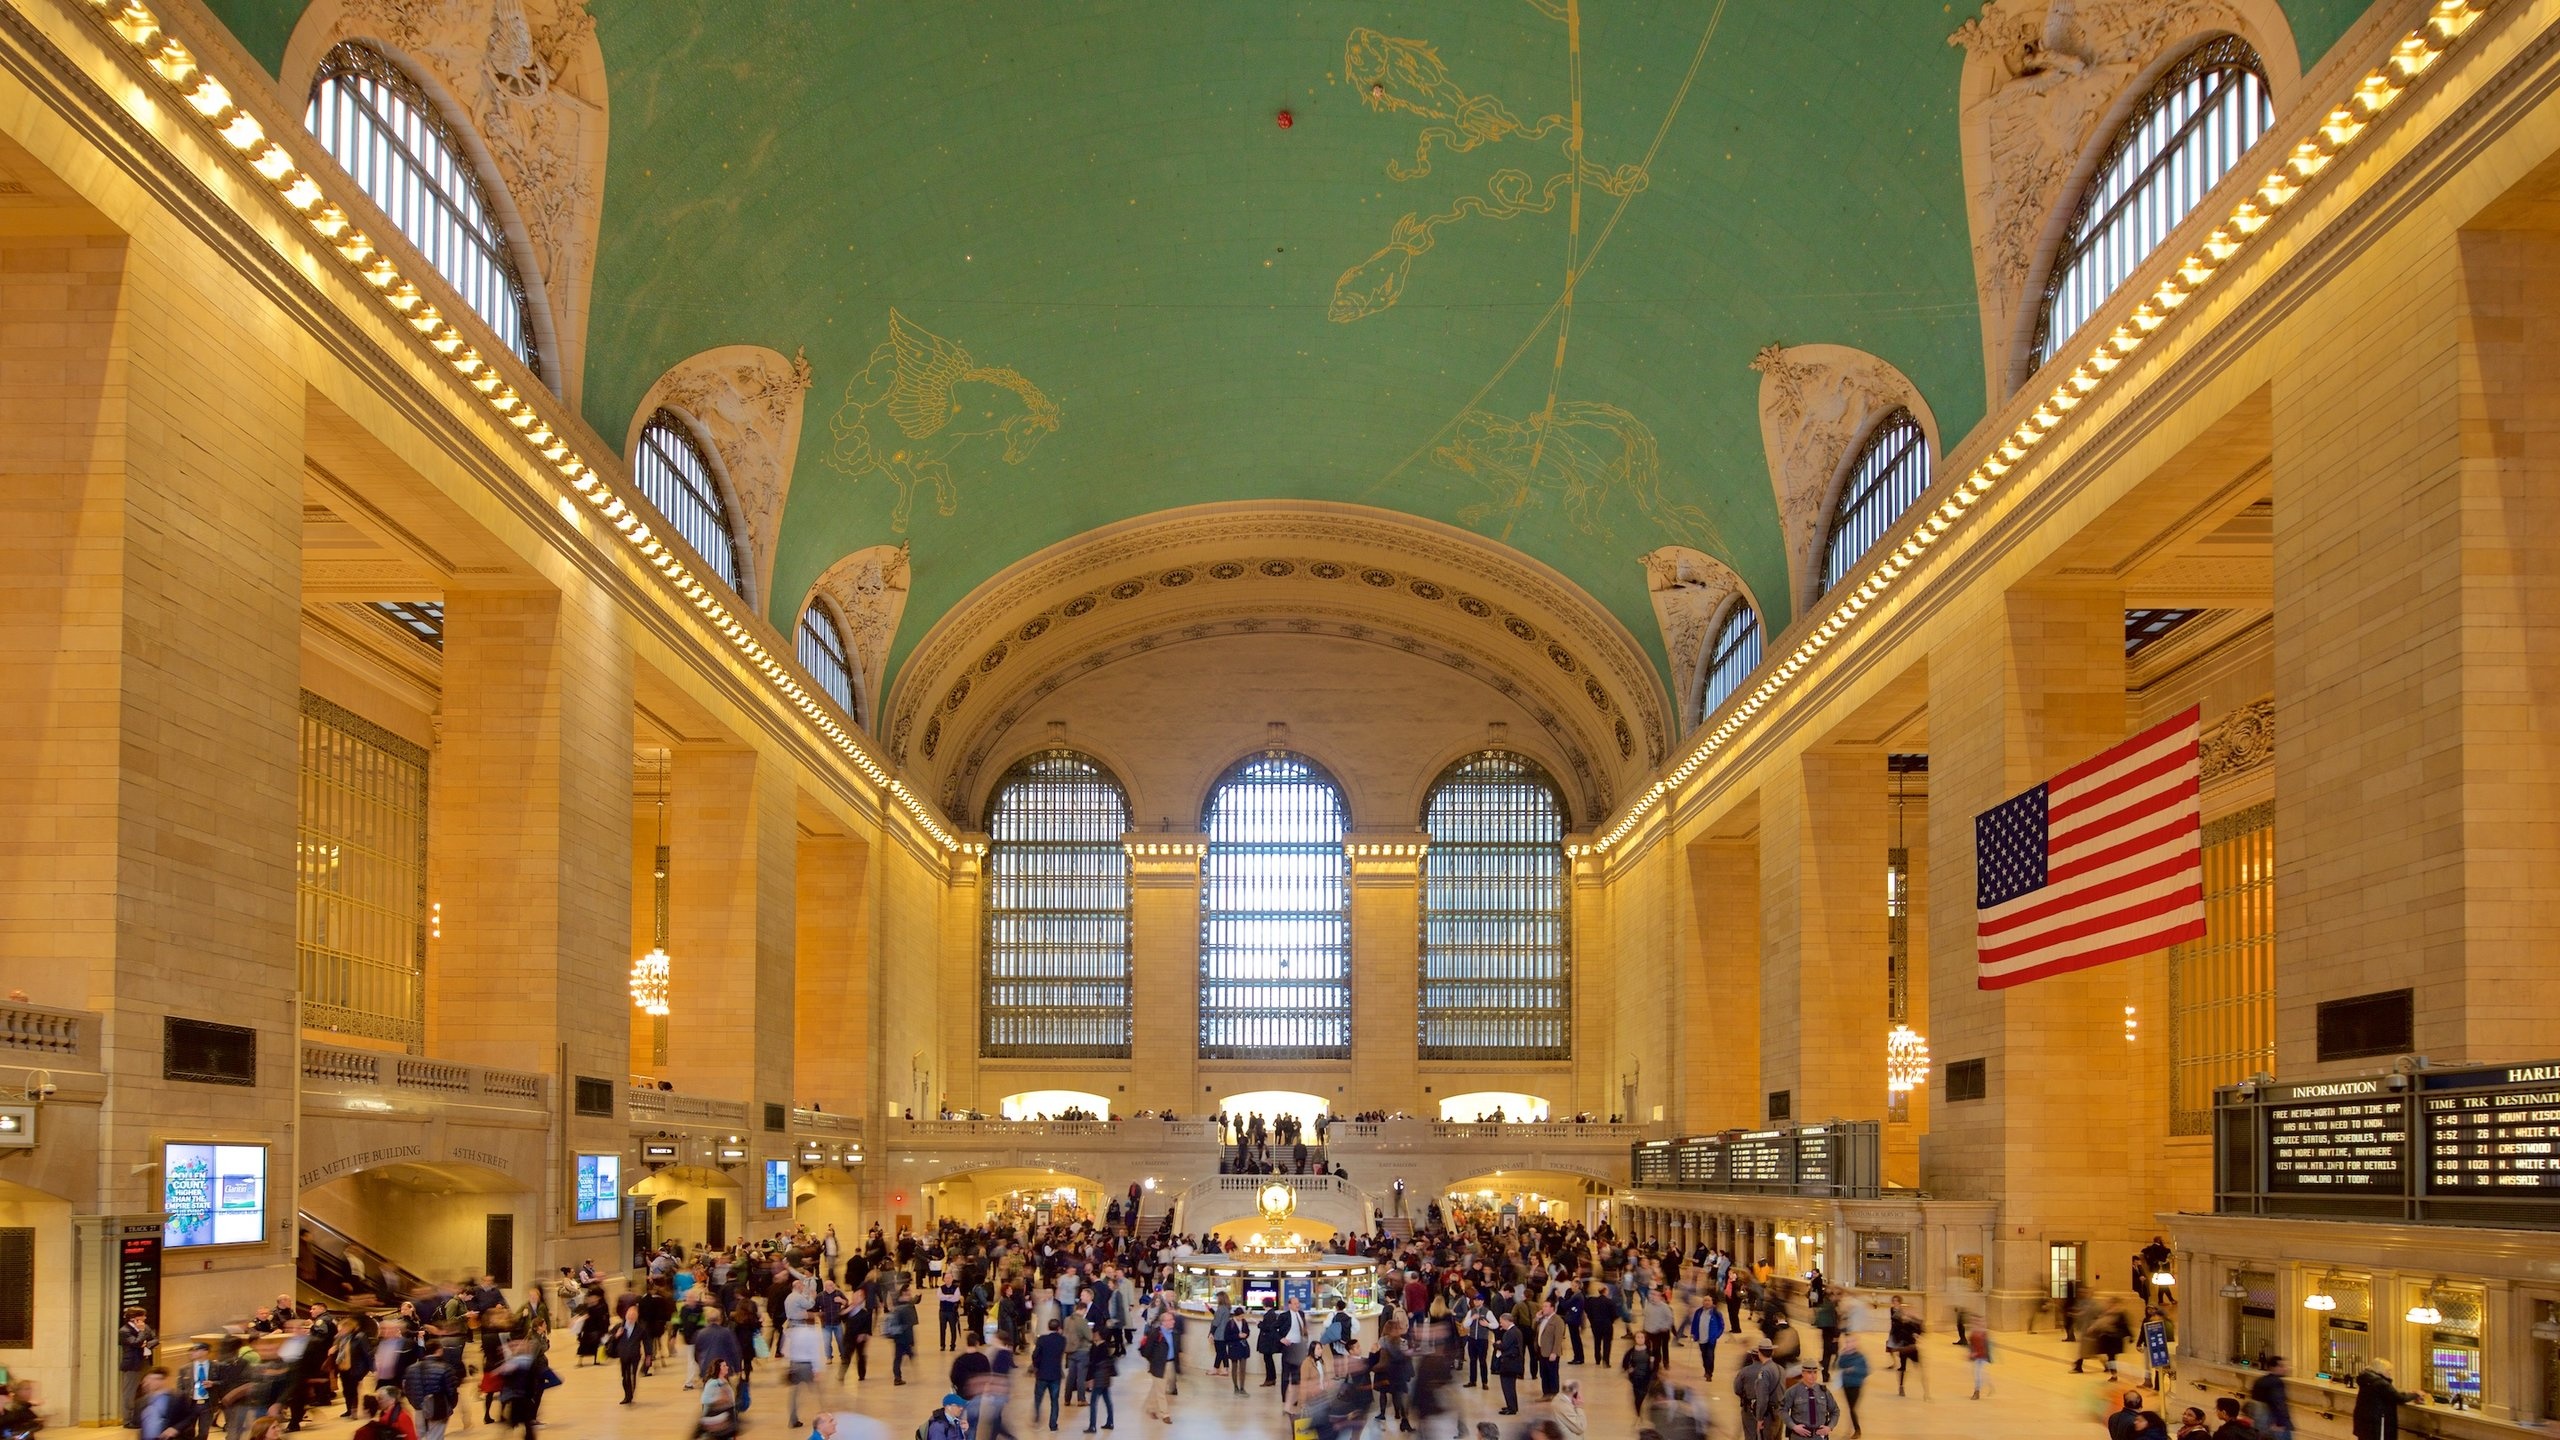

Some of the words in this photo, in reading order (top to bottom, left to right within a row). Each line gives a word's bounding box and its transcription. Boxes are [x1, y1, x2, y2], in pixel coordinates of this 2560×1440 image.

[2293, 1081, 2377, 1098] INFORMATION
[2428, 1099, 2456, 1109] TIME
[2463, 1097, 2488, 1108] TRK
[2495, 1092, 2560, 1106] DESTINATI
[2273, 1110, 2288, 1119] FREE
[2291, 1107, 2335, 1118] METRO-NORTH
[2339, 1106, 2361, 1116] TRAIN
[2364, 1104, 2382, 1114] TIME
[2386, 1103, 2401, 1113] APP
[2436, 1115, 2458, 1125] 5:49
[2498, 1112, 2527, 1122] MOUNT
[2283, 1122, 2296, 1131] HAS
[2298, 1122, 2311, 1131] ALL
[2314, 1121, 2327, 1130] YOU
[2330, 1120, 2348, 1129] NEED
[2352, 1120, 2361, 1129] TO
[2364, 1119, 2386, 1128] KNOW.
[2273, 1136, 2300, 1144] SERVICE
[2302, 1135, 2331, 1144] STATUS,
[2335, 1133, 2377, 1143] SCHEDULES,
[2381, 1132, 2405, 1142] FARES
[2436, 1130, 2458, 1140] 5:52
[2477, 1129, 2489, 1139] 26
[2498, 1128, 2509, 1138] N.
[2515, 1127, 2545, 1138] WHITE
[2280, 1149, 2292, 1157] AND
[2355, 1147, 2392, 1156] ANYWHERE
[2436, 1145, 2458, 1155] 5:58
[2477, 1144, 2488, 1154] 21
[2498, 1143, 2551, 1154] CRESTWOOD
[452, 1147, 476, 1160] 45TH
[477, 1153, 509, 1169] STREET
[298, 1169, 320, 1188] THE
[322, 1151, 370, 1176] METLIFE
[372, 1145, 421, 1161] BUILDING
[2295, 1161, 2344, 1170] WWW.MTA.INFO
[2347, 1161, 2361, 1170] FOR
[2364, 1161, 2397, 1170] DETAILS
[2436, 1160, 2458, 1170] 6:00
[2468, 1160, 2489, 1170] 102A
[2498, 1160, 2510, 1170] N.
[2515, 1159, 2545, 1169] WHITE
[171, 1172, 206, 1180] POLLEN
[2299, 1175, 2331, 1184] DOWNLOAD
[2335, 1174, 2343, 1183] IT
[2347, 1175, 2373, 1184] TODAY.
[2436, 1175, 2459, 1185] 6:04
[2477, 1175, 2489, 1185] 30
[2498, 1175, 2540, 1186] WASSAIC
[173, 1180, 207, 1189] COUNT:
[224, 1184, 248, 1193] Claritin
